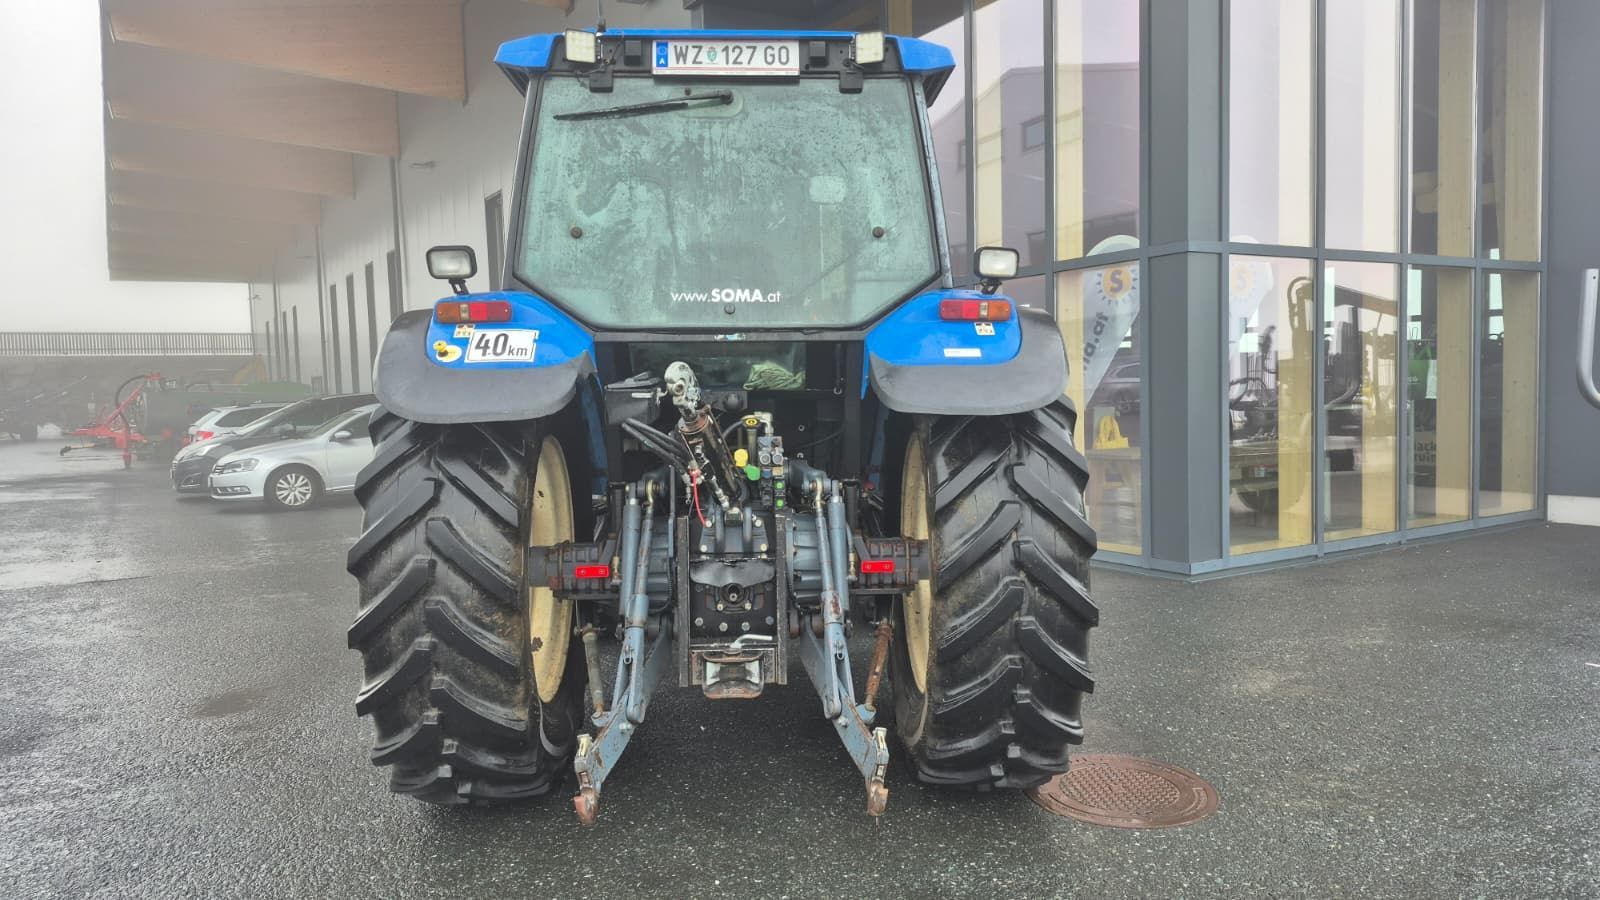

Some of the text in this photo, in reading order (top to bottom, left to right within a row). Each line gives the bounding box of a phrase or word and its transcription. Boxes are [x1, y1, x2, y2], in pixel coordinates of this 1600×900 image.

[658, 57, 666, 65] A
[674, 45, 704, 65] WZ
[721, 45, 757, 65] 127
[1110, 269, 1123, 293] S
[670, 288, 781, 303] www.SOMA.at
[475, 333, 528, 357] 40 km
